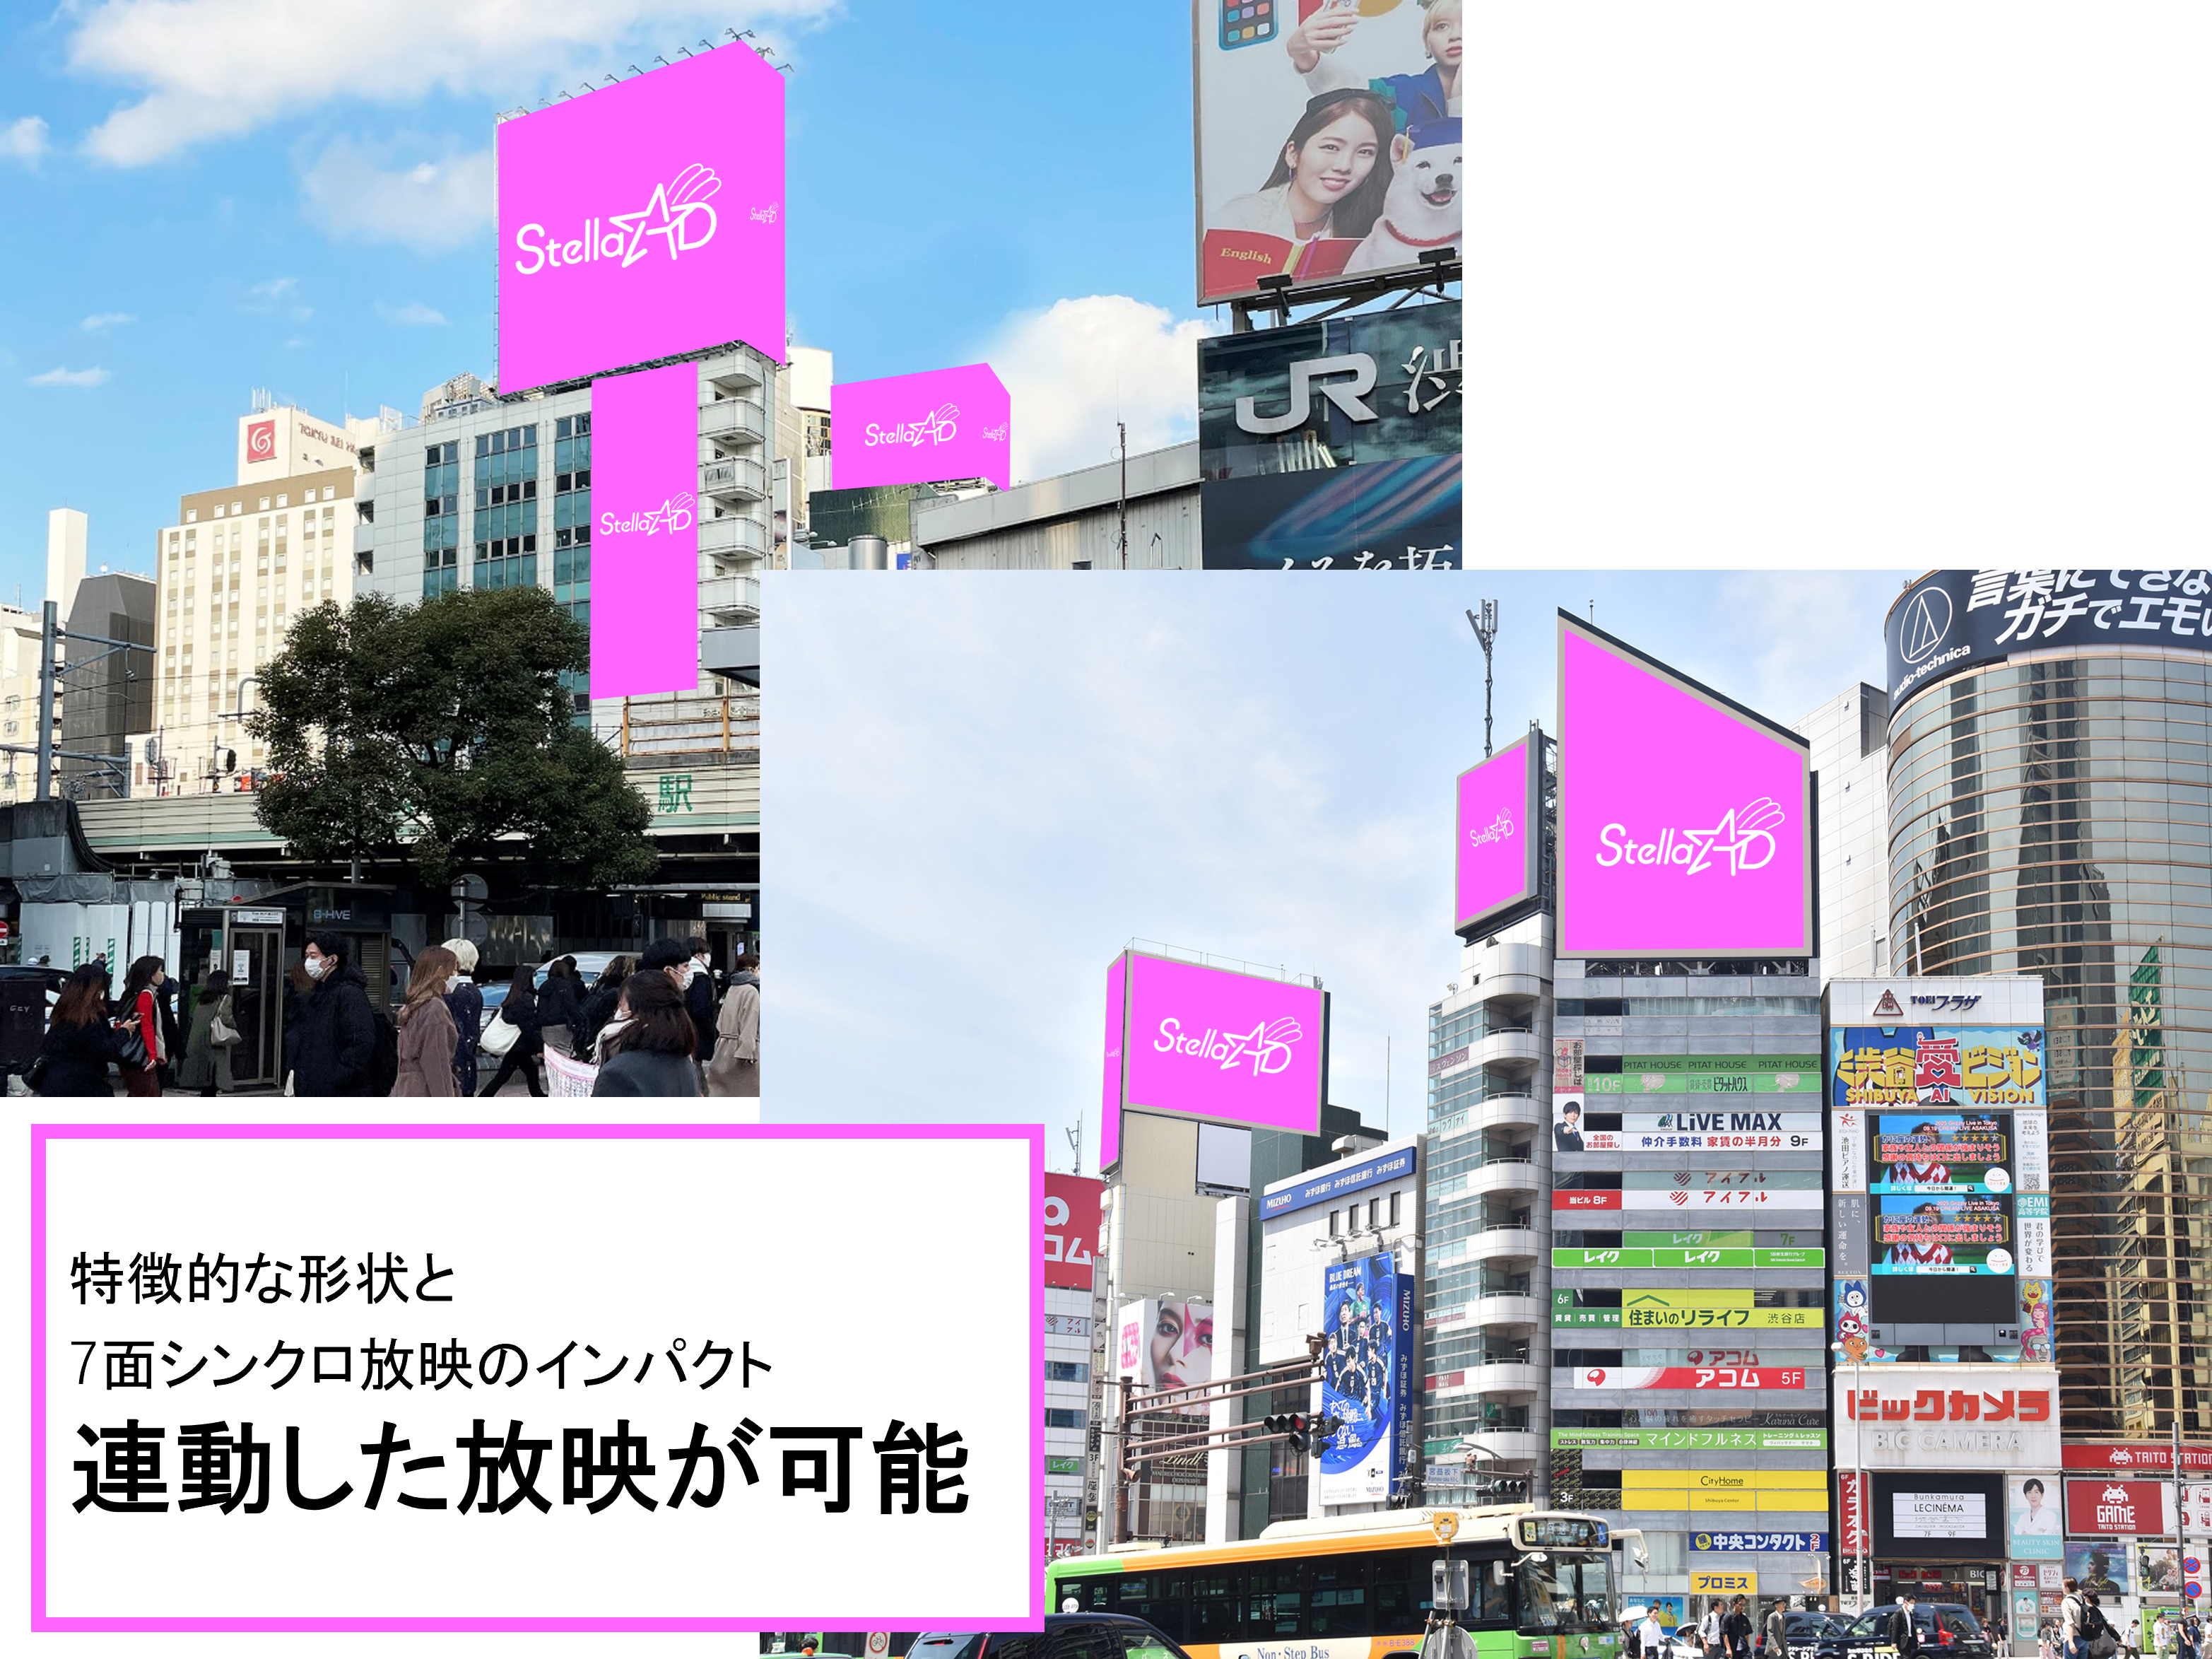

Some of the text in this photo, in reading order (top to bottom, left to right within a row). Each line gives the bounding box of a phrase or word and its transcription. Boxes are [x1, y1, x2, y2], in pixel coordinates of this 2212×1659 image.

[1220, 247, 1272, 264] English
[1235, 353, 1378, 434] JR
[1893, 645, 1971, 701] audio-technica
[659, 775, 693, 813] 駅
[1623, 1060, 1682, 1070] PITAT HOUSE
[1688, 1060, 1747, 1069] PITAT HOUSE
[1758, 1060, 1818, 1069] PITAT HOUSE
[1846, 1088, 2034, 1103] SHIBUYA AI VISION
[1731, 1113, 1782, 1131] MAX
[1641, 1135, 1808, 1148] 仲介手数料 家賃の半月分 9F
[1882, 1144, 2000, 1152] 家族や友人との関係が強まりそう
[1841, 1136, 1850, 1189] 池田ピアノ運送
[1882, 1153, 2000, 1161] 感謝の気持ちは口に出しましょう
[1266, 1193, 1292, 1209] MIZUHO
[1569, 1195, 1607, 1205] 当ビル 8F
[1703, 1191, 1767, 1204] アイフル
[2028, 1197, 2048, 1207] EMI
[1851, 1200, 1860, 1224] 肌に、
[1837, 1199, 1849, 1266] 新しい運命を。
[1883, 1224, 2002, 1233] 家族や友人との関係が強まりそう
[1673, 1233, 1702, 1244] レイク
[1780, 1233, 1795, 1245] 7F
[1883, 1233, 2003, 1242] 感謝の気持ちは口に出しましょう
[2035, 1222, 2045, 1262] 君の学びで
[2024, 1222, 2032, 1272] 世界が変わる
[1584, 1250, 1620, 1264] レイク
[1685, 1250, 1720, 1263] レイク
[1329, 1266, 1361, 1283] BLUE DREAM
[1557, 1295, 1570, 1304] 6F
[1402, 1289, 1411, 1332] MIZUHO
[1555, 1313, 1620, 1323] 賃貸 売買 管理
[1629, 1309, 1806, 1327] 住まいのリライフ 渋谷店
[1709, 1350, 1759, 1366] アコム
[1696, 1368, 1801, 1388] アコム 5F
[1847, 1389, 2049, 1421] ビックカメラ
[1798, 1413, 1820, 1426] Cure
[1646, 1432, 1757, 1446] マインドフルネス
[1872, 1431, 2026, 1451] BIC CAMERA
[2135, 1452, 2166, 1463] TAITO
[1560, 1492, 1573, 1502] 3F
[2096, 1505, 2136, 1523] GAME
[1713, 1533, 1806, 1551] 中央コンタクト
[1698, 1576, 1748, 1589] プロミス
[1310, 1646, 1329, 1658] Bus
